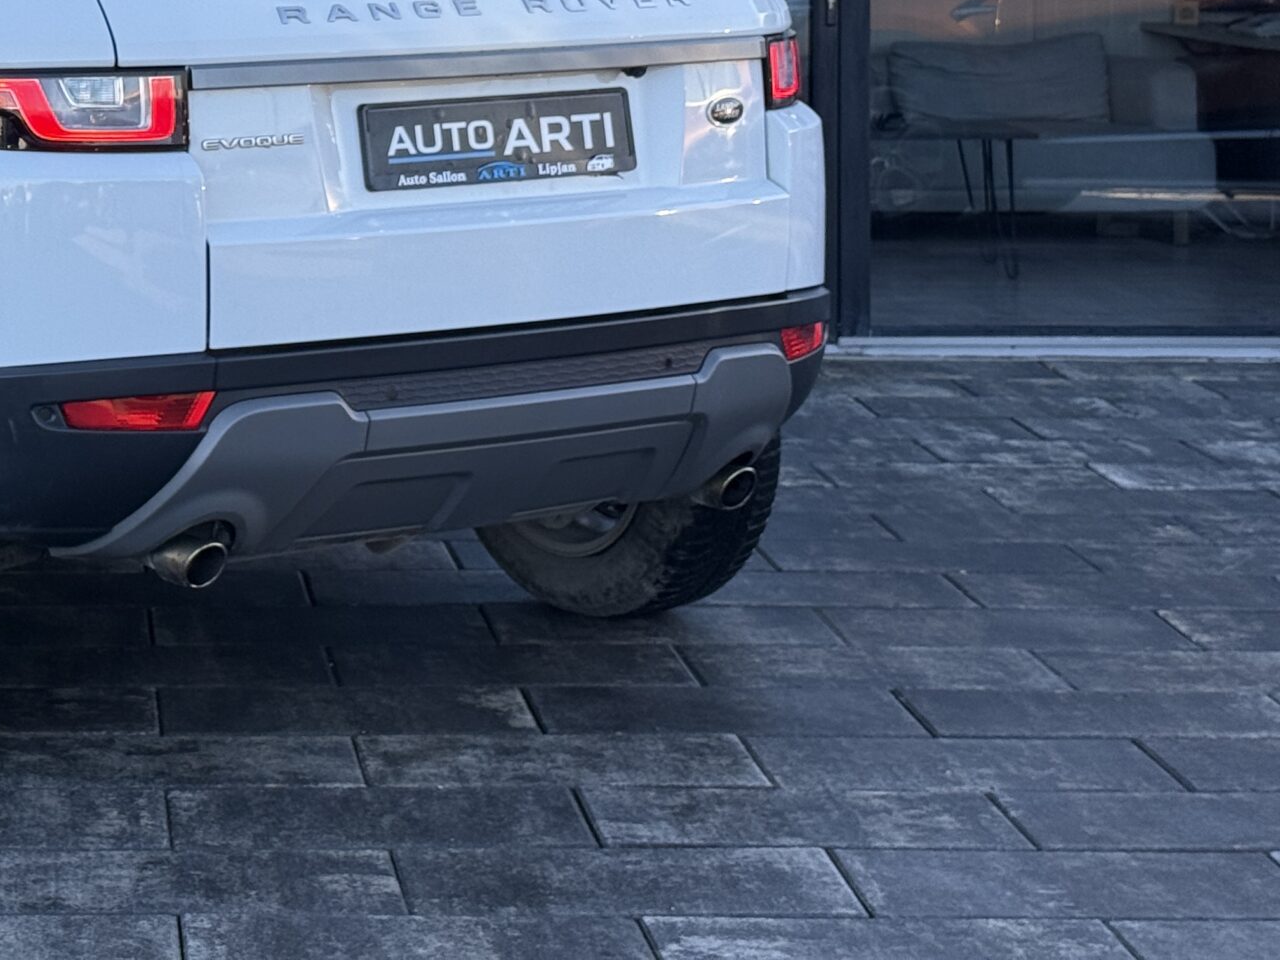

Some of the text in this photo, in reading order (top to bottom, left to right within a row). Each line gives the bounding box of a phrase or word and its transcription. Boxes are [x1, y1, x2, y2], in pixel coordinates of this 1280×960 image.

[202, 134, 305, 151] EVOQUE
[388, 112, 616, 157] AUTO ARTI
[398, 172, 427, 187] Auto
[478, 166, 526, 180] ARTI
[538, 162, 577, 177] Lipjan
